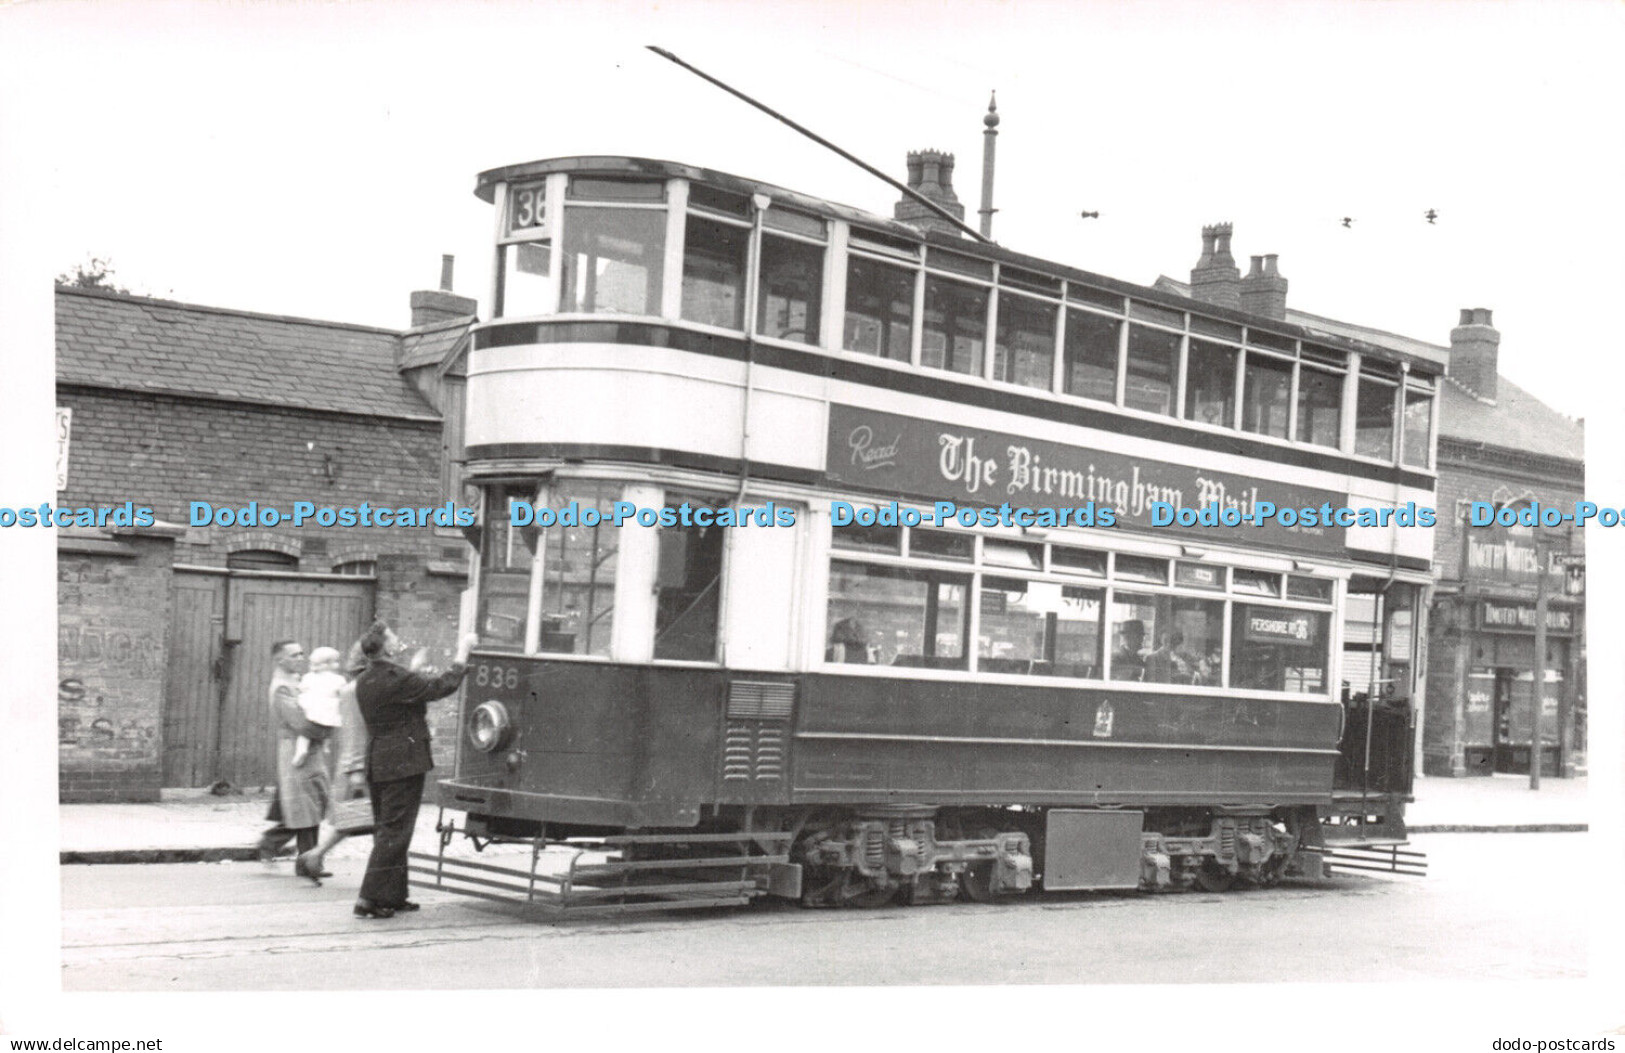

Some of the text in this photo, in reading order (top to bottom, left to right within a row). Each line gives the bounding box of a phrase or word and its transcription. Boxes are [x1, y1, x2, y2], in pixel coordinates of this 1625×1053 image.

[849, 425, 901, 465] Read
[937, 432, 998, 493] The
[1006, 445, 1183, 518] Birmingham
[476, 664, 519, 689] 836
